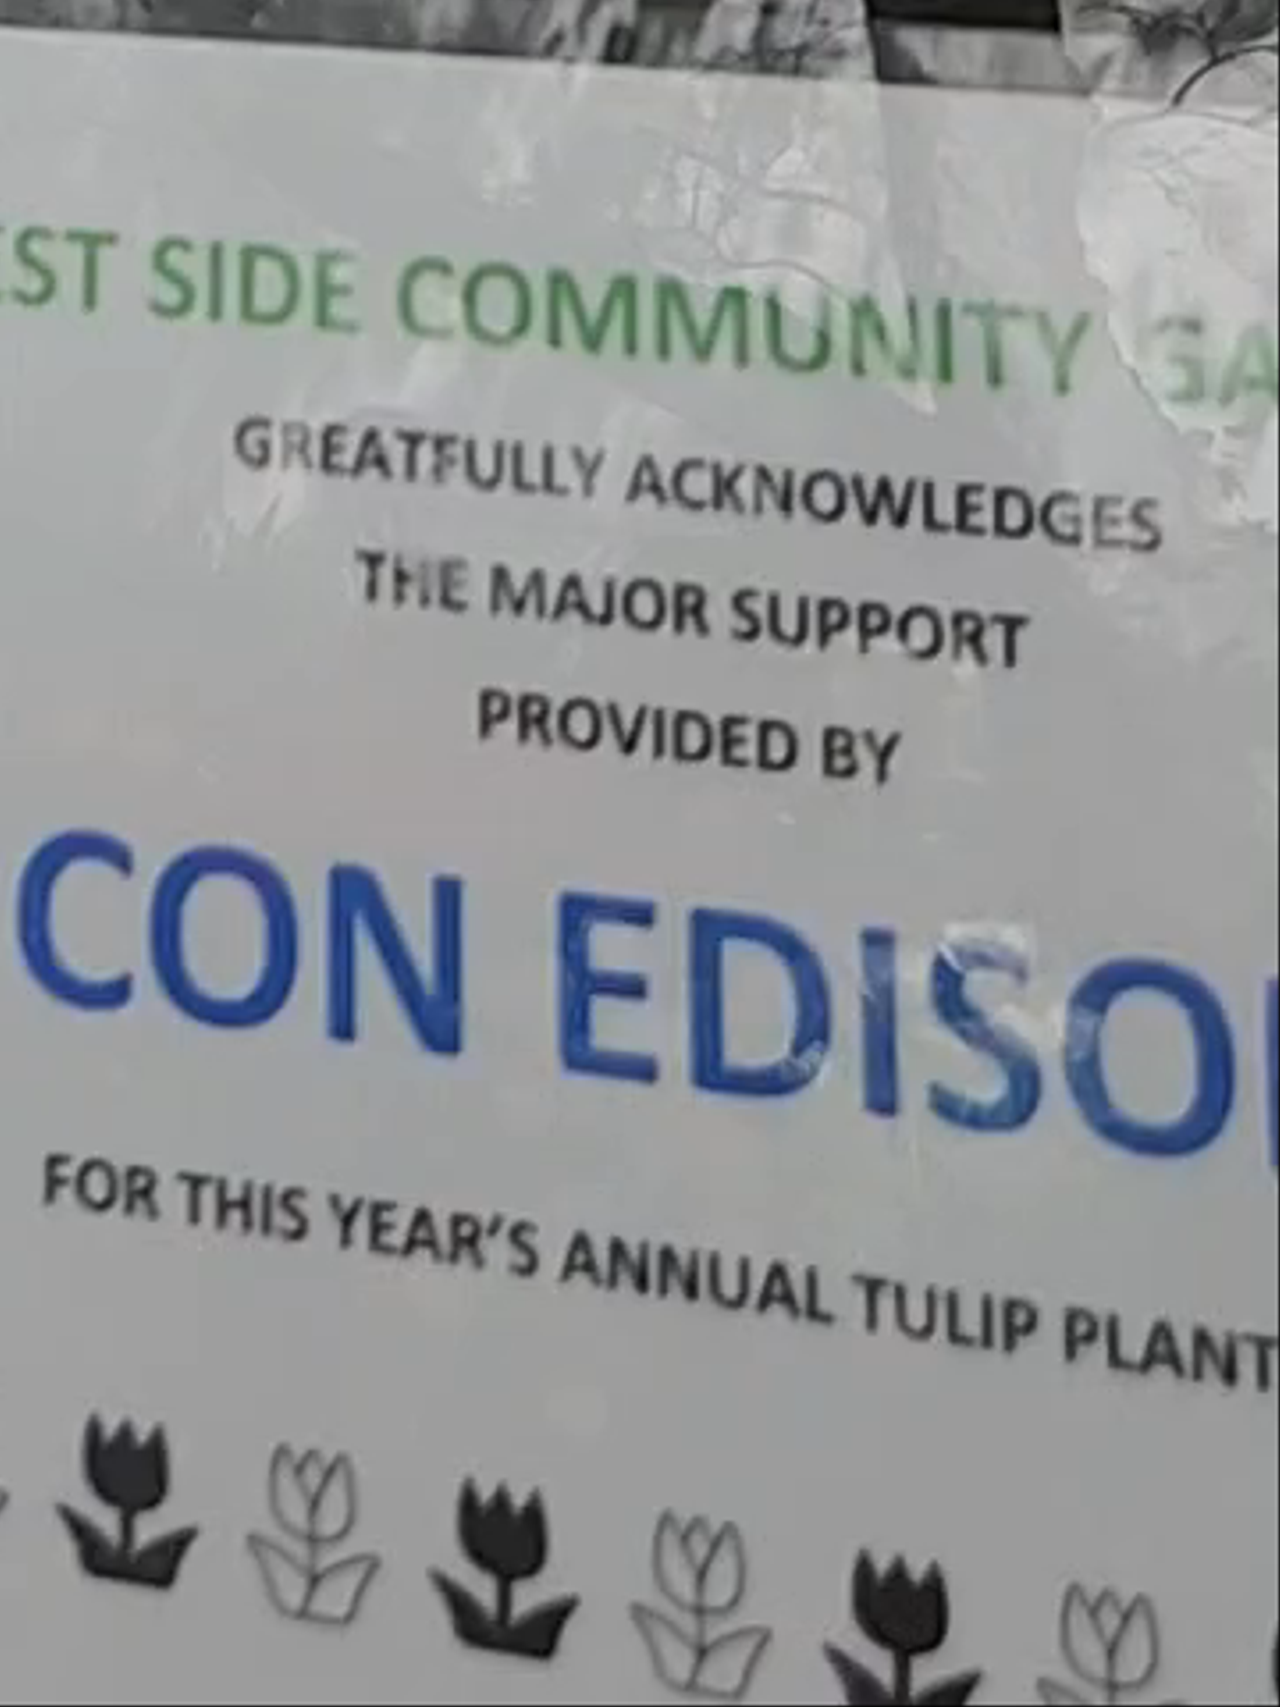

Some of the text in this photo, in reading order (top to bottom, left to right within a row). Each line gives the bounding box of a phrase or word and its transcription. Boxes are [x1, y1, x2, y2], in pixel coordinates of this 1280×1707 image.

[151, 233, 364, 337] SIDE
[397, 252, 1093, 401] COMMUNITY
[231, 414, 1164, 556] GREATFULLY ACKNOWLEDGES
[354, 547, 1033, 673] THE MAJOR SUPPORT
[475, 687, 905, 790] PROVIDED BY
[15, 826, 1280, 1172] CON EDISO
[40, 1152, 162, 1222] FOR
[177, 1169, 312, 1246] THIS
[559, 1230, 837, 1328] ANNUAL
[851, 1273, 1041, 1356] TULIP
